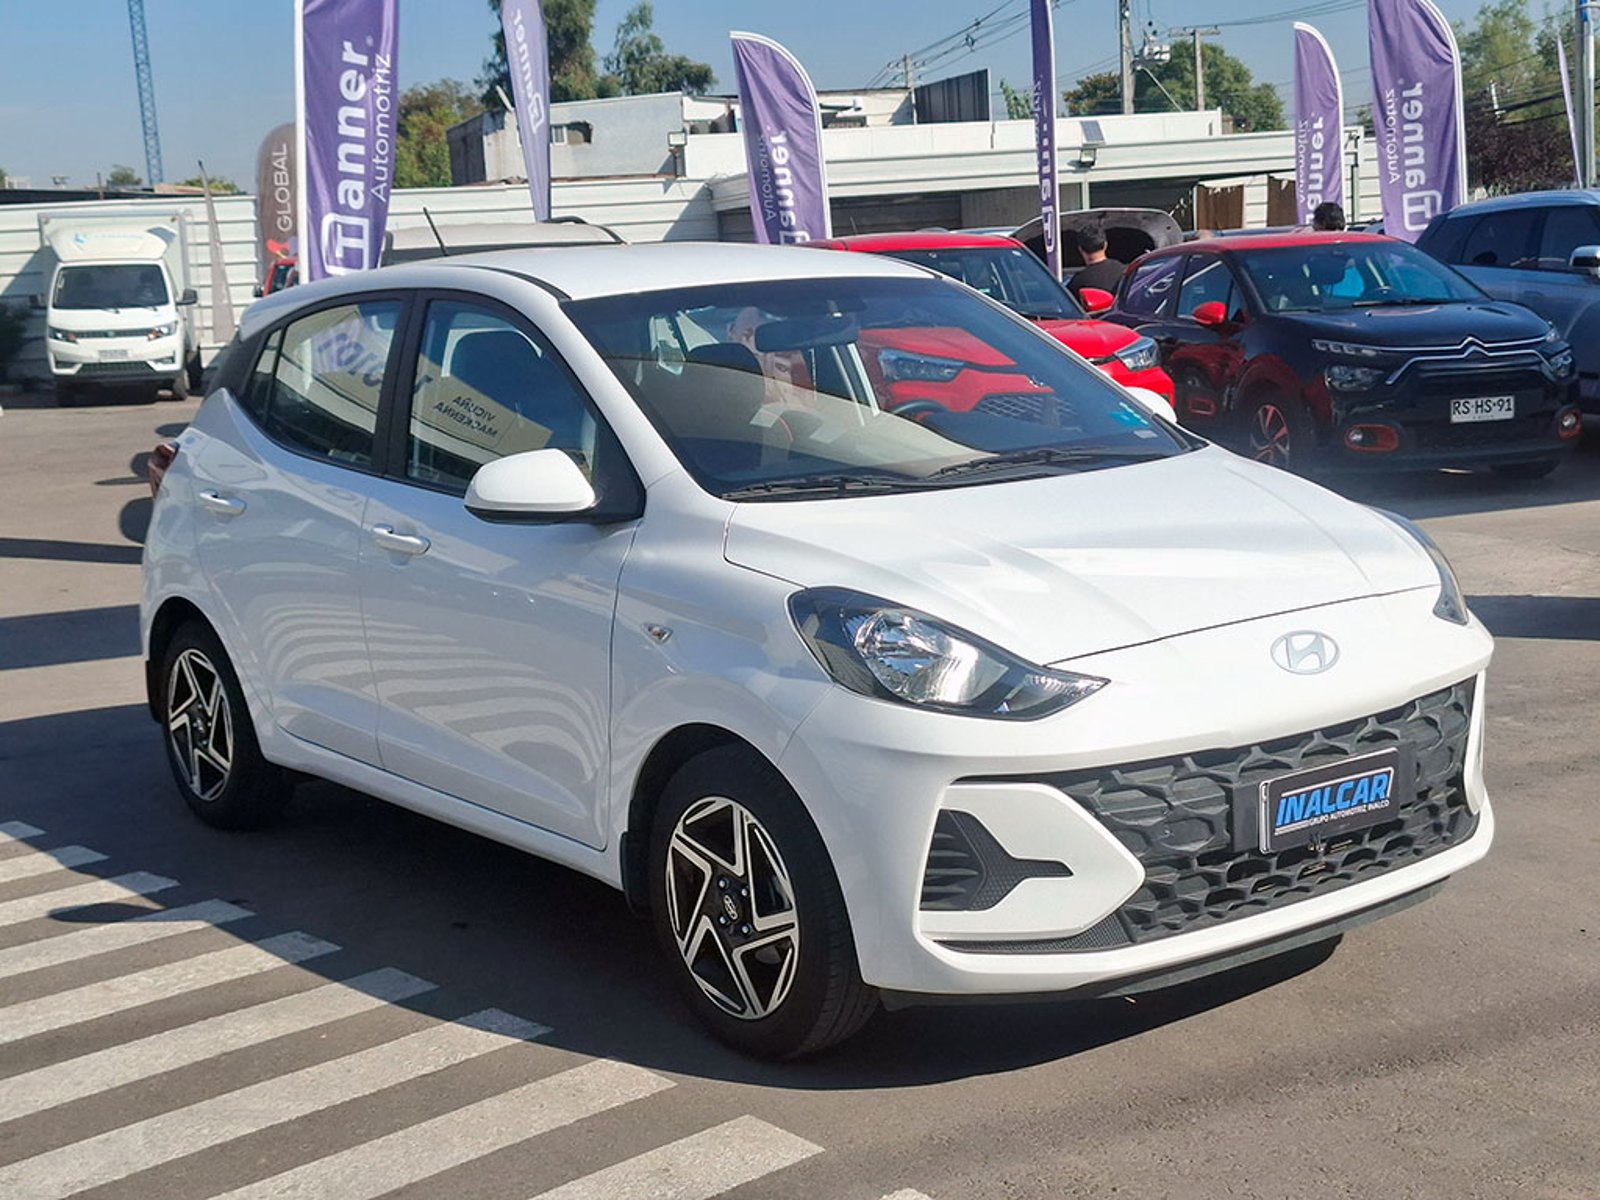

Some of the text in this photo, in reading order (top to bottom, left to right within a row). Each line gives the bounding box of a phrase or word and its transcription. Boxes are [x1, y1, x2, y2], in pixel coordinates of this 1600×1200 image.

[272, 143, 294, 232] GLOBAL
[321, 40, 370, 276] Tanner
[370, 53, 392, 203] Automotriz
[1275, 772, 1390, 827] INALCAR
